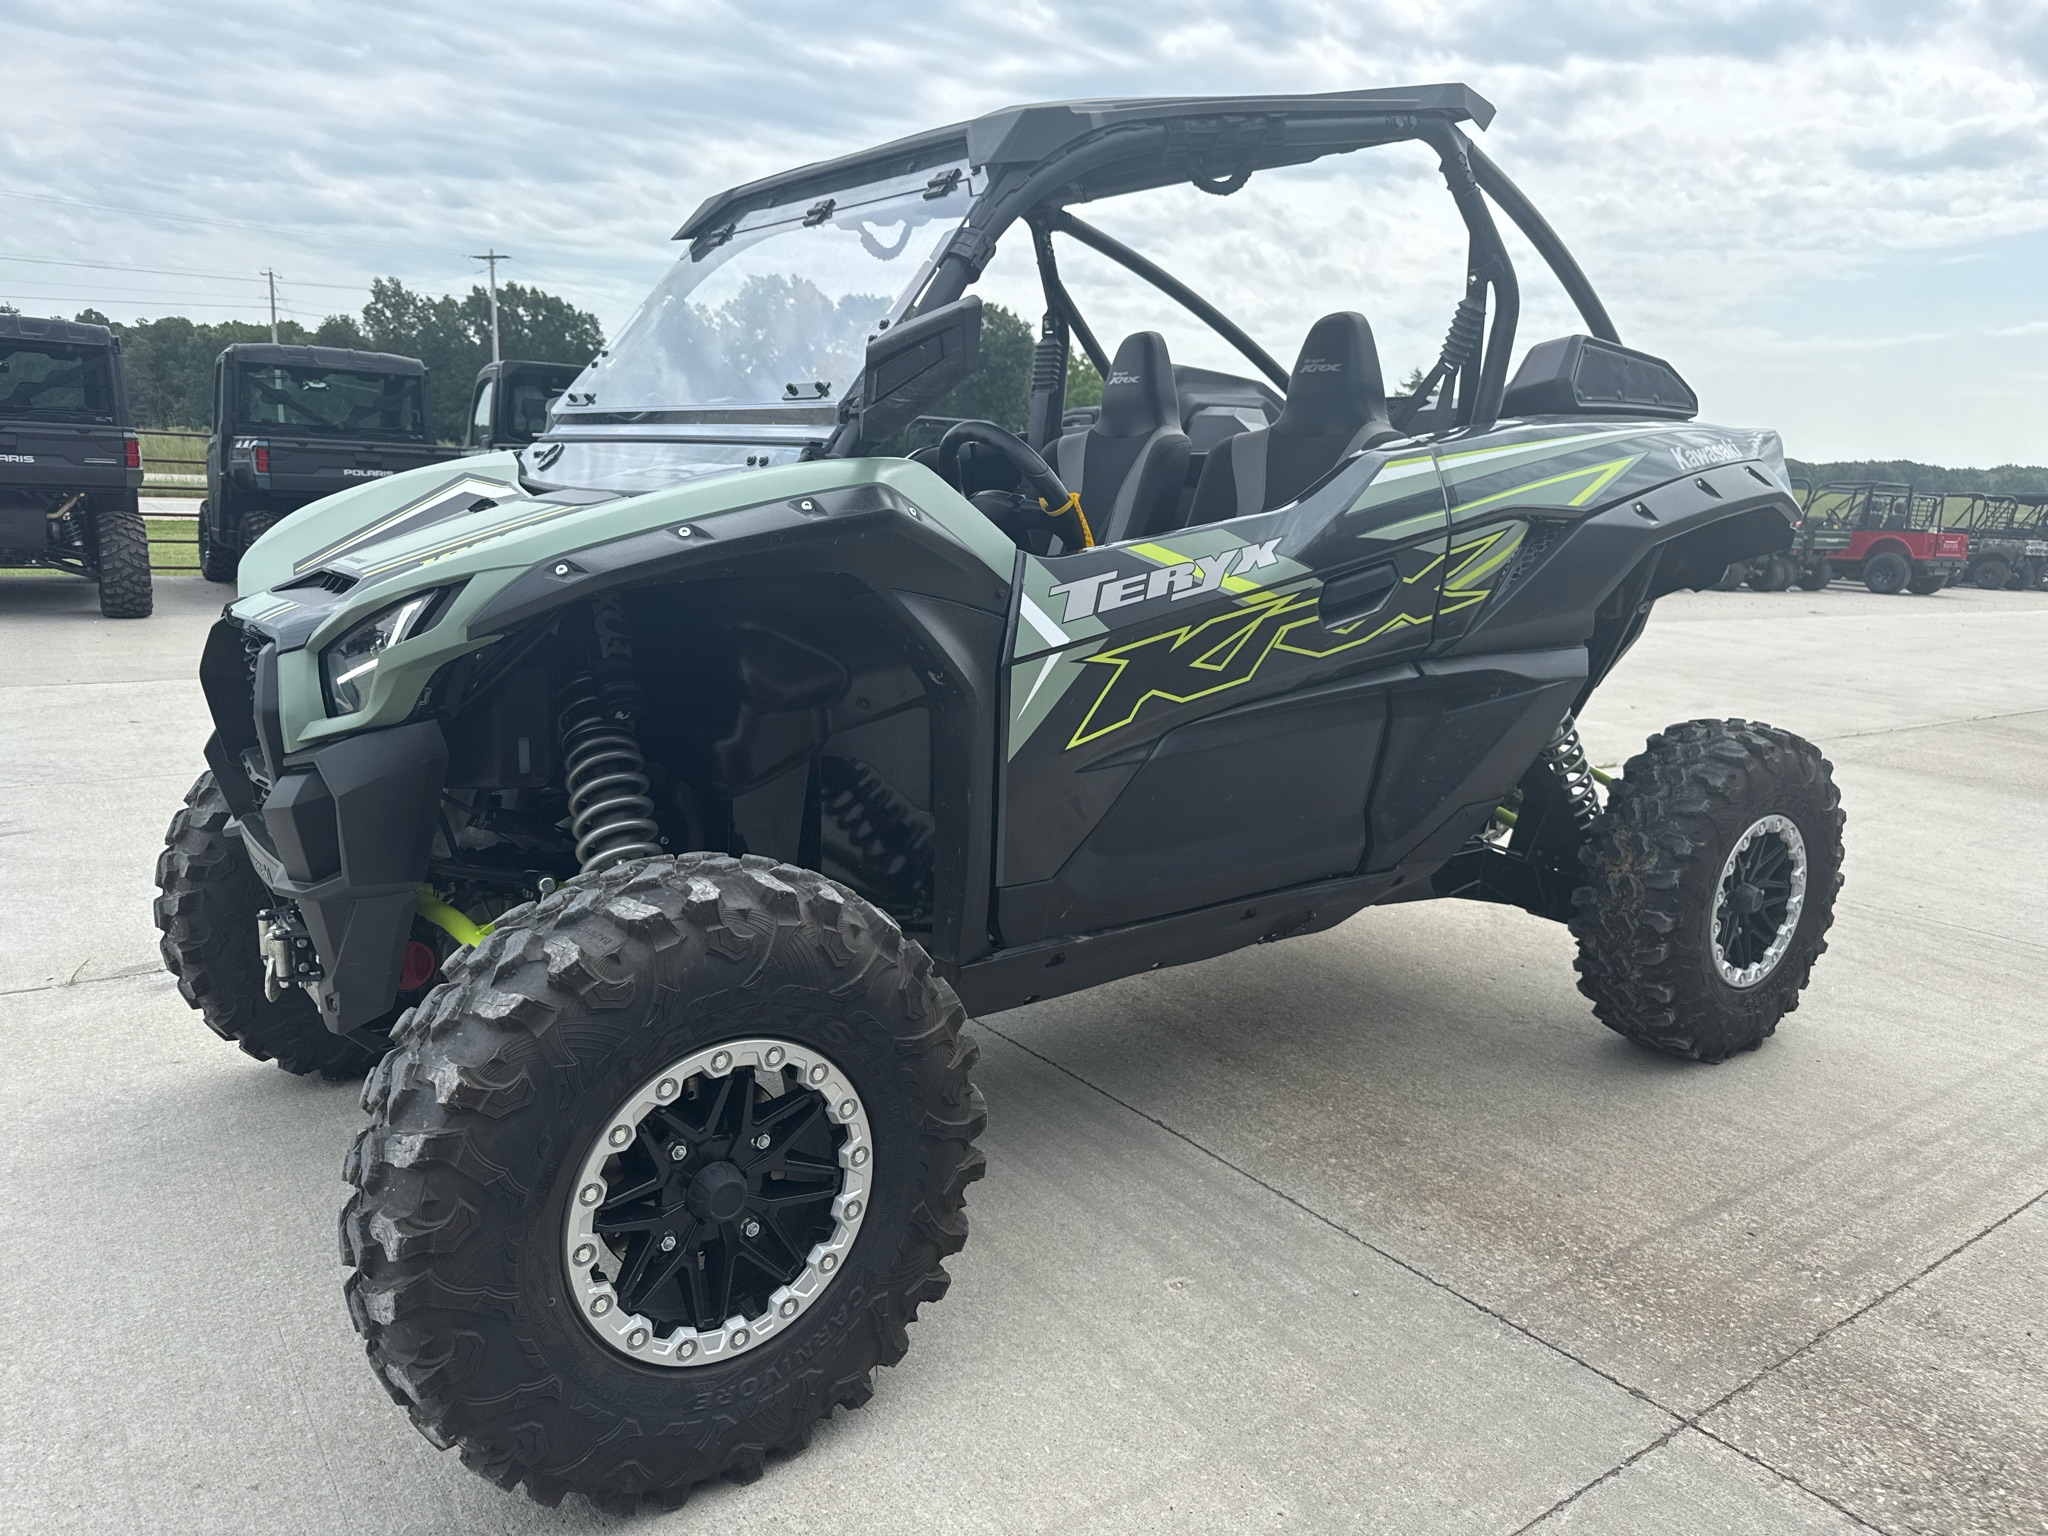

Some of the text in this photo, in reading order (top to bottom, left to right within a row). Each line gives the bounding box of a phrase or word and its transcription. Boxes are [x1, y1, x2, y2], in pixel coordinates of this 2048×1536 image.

[1299, 363, 1343, 374] KRX
[1109, 376, 1141, 385] KRX
[1669, 438, 1744, 471] Kawasaki
[343, 469, 394, 477] POLARIS
[693, 1285, 866, 1411] CARNIVORE
